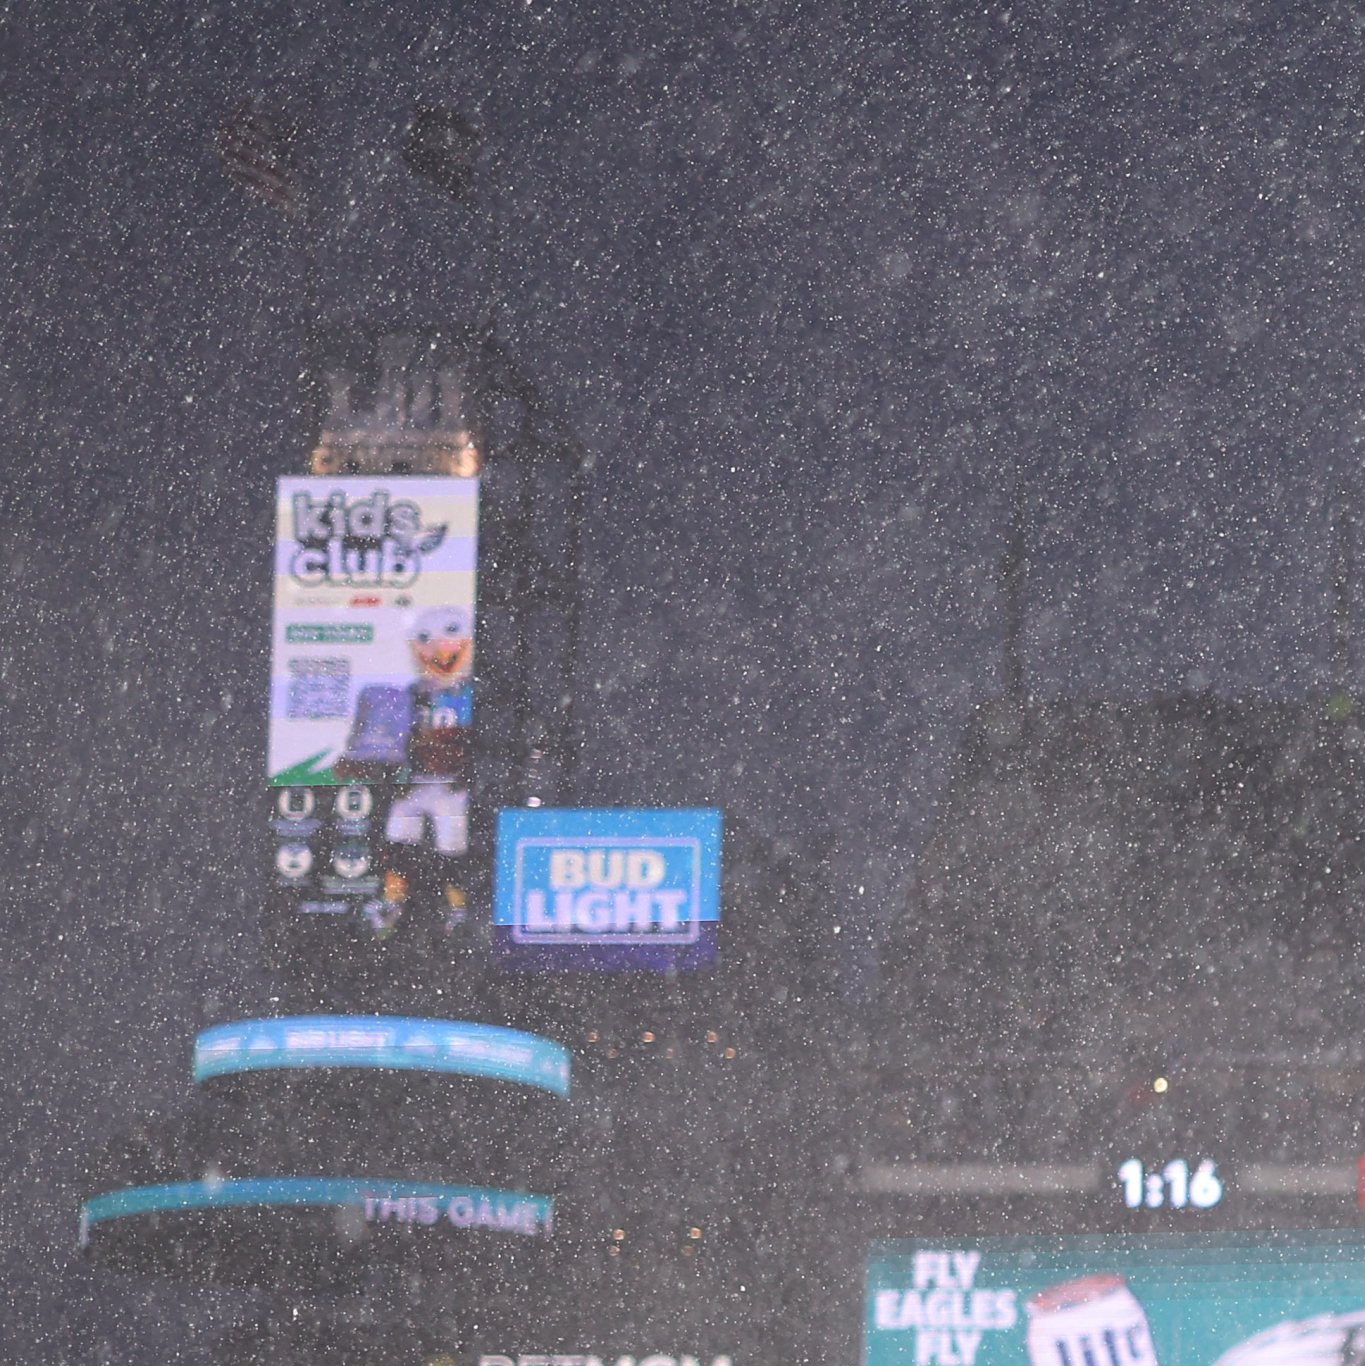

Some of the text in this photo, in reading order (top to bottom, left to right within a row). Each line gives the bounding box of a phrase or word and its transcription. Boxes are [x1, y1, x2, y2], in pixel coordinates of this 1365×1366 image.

[291, 491, 420, 539] kids
[290, 537, 420, 589] club
[550, 850, 666, 889] BUD
[526, 890, 688, 933] LIGHT
[1119, 1158, 1223, 1208] 1:16
[361, 1192, 438, 1225] THIS
[912, 1251, 981, 1289] FLY
[875, 1289, 1017, 1329] EAGLES
